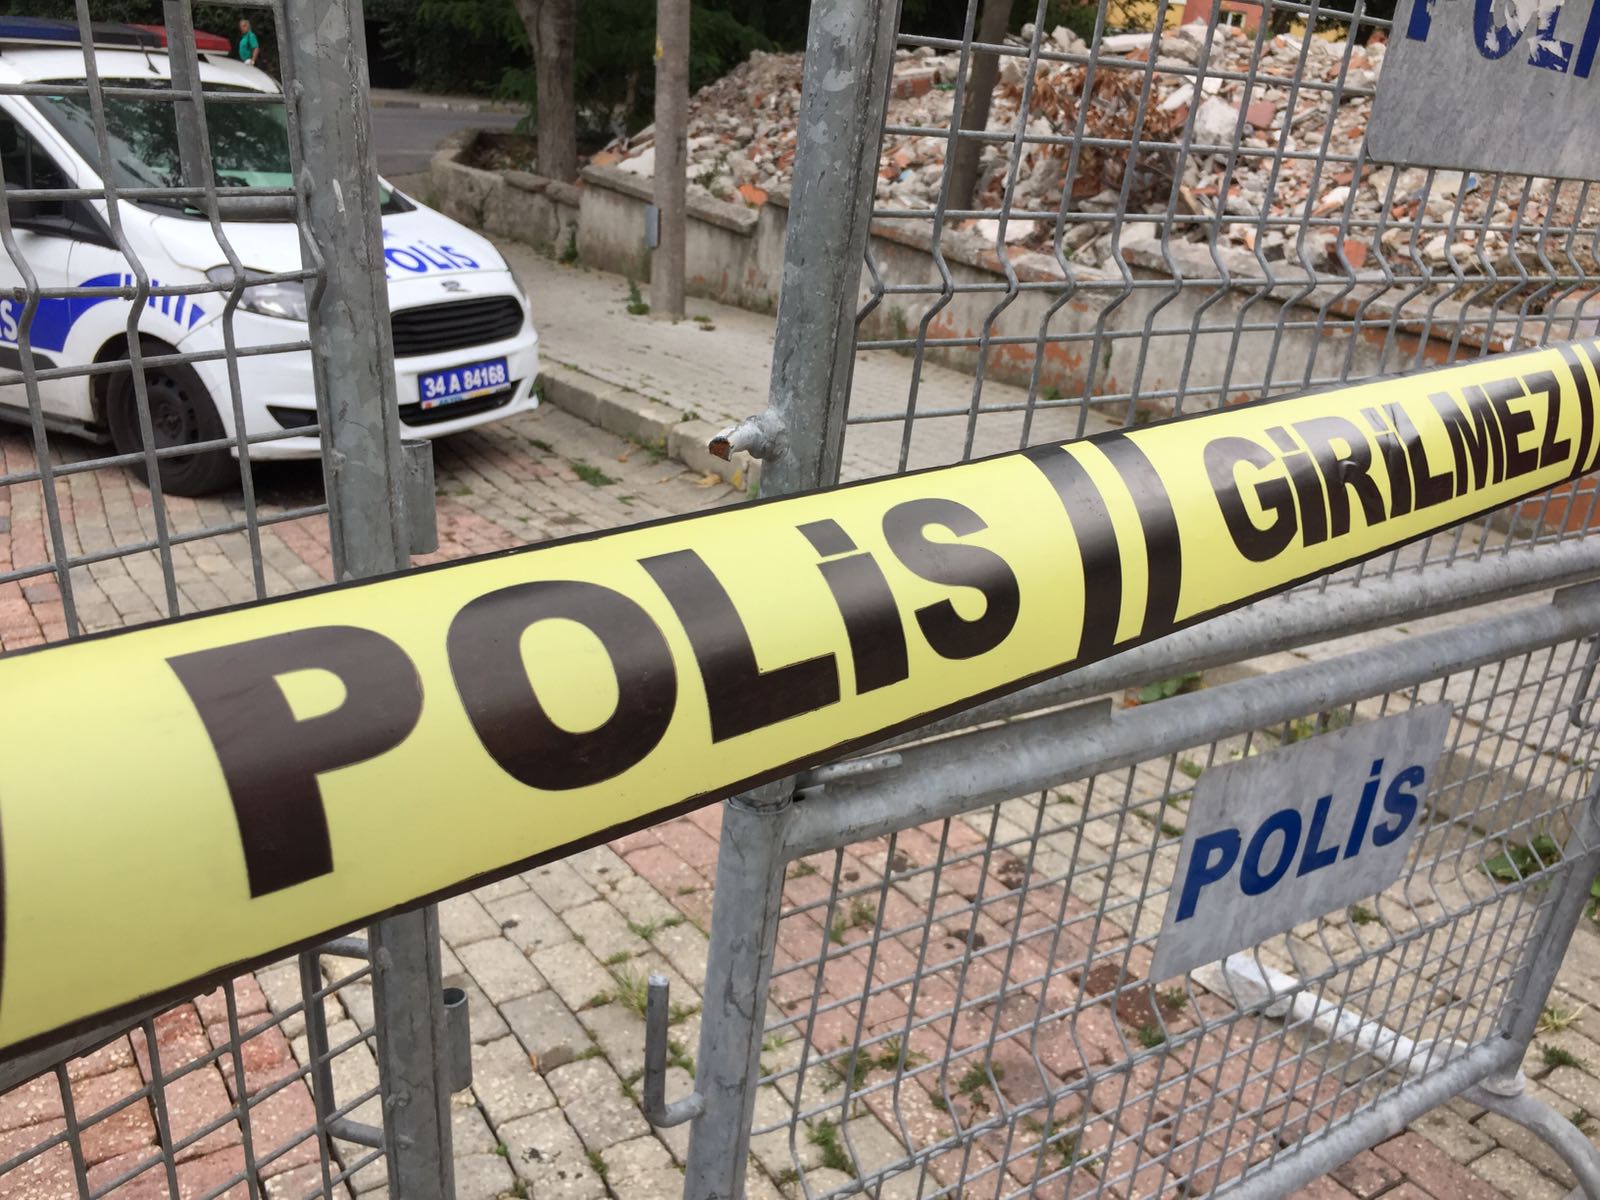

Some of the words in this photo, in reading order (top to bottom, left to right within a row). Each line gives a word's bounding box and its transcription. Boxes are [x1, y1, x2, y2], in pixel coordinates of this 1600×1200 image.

[384, 240, 479, 279] OLİS
[424, 375, 446, 398] 34
[449, 373, 461, 394] A
[463, 364, 505, 391] 84168
[165, 497, 1021, 898] POLİS
[1203, 370, 1571, 562] GİRİLMEZ
[1175, 758, 1425, 923] POLİS
